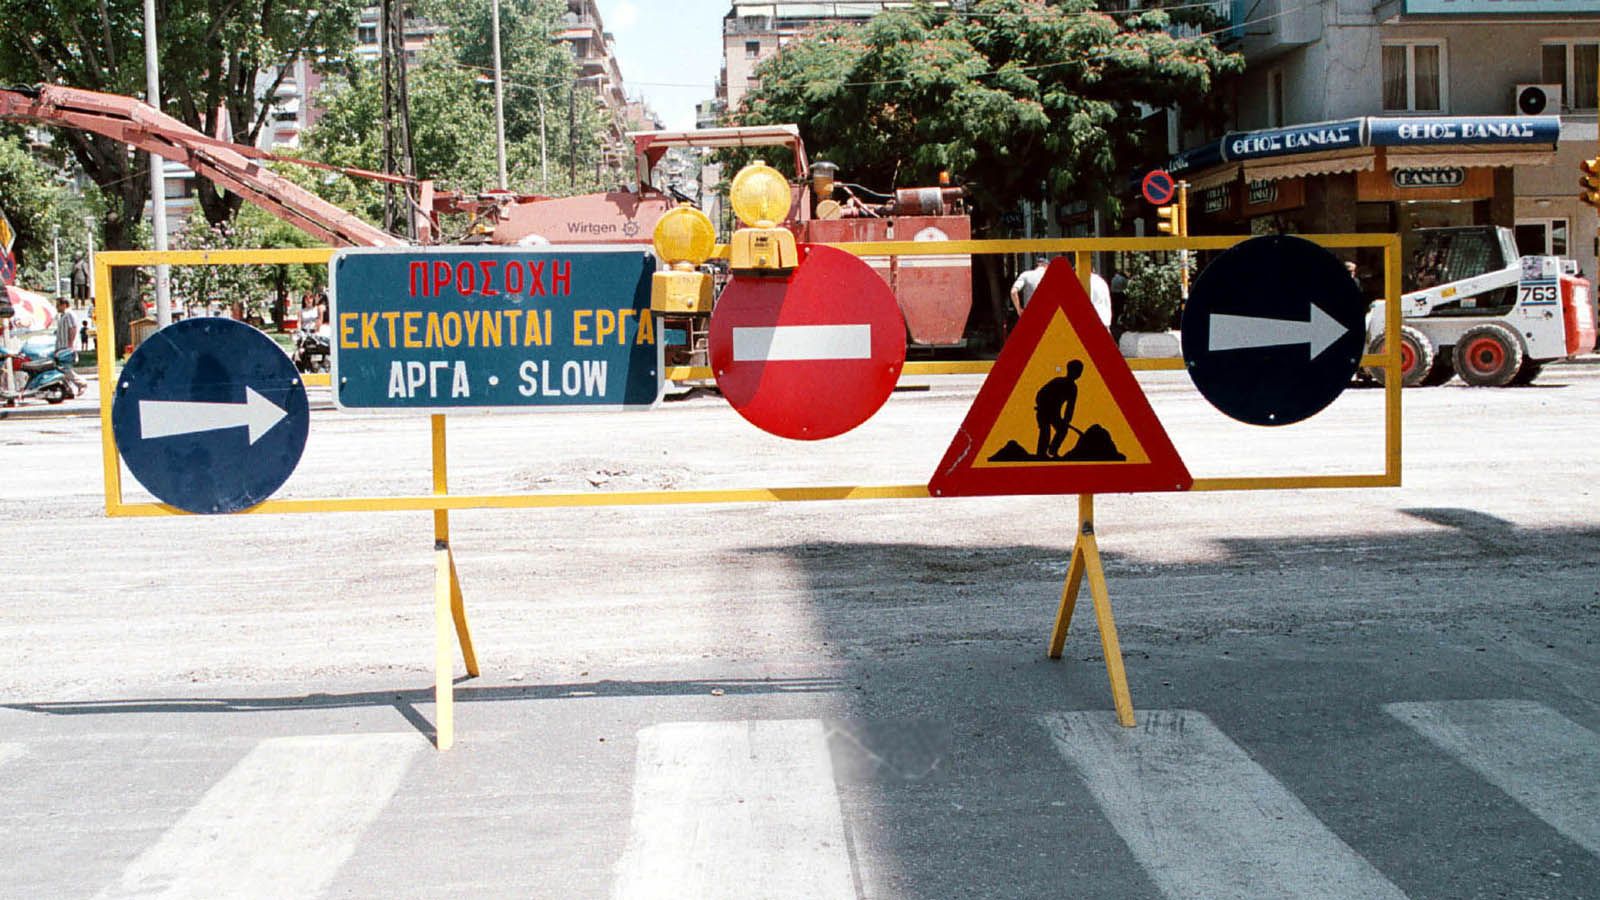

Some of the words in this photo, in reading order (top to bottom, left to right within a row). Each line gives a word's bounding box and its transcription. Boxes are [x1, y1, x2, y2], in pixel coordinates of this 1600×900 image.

[1232, 136, 1282, 154] ΘΕΙΟΣ
[1285, 127, 1350, 148] ΒΑΝΙΑΣ
[1398, 122, 1456, 139] ΘΕΙΟΣ
[1461, 121, 1534, 138] ΒΑΝΙΑΣ
[567, 222, 617, 235] Wirtgen
[408, 260, 572, 297] ΠΡΟΣΟΧΗ
[1520, 286, 1557, 302] 763
[340, 309, 552, 349] ΕΚΤΕΛΟΥΝΤΑΙ
[573, 308, 656, 346] ΕΡΓΑ
[388, 361, 470, 398] ΑΡΓΑ
[518, 360, 608, 397] SLOW
